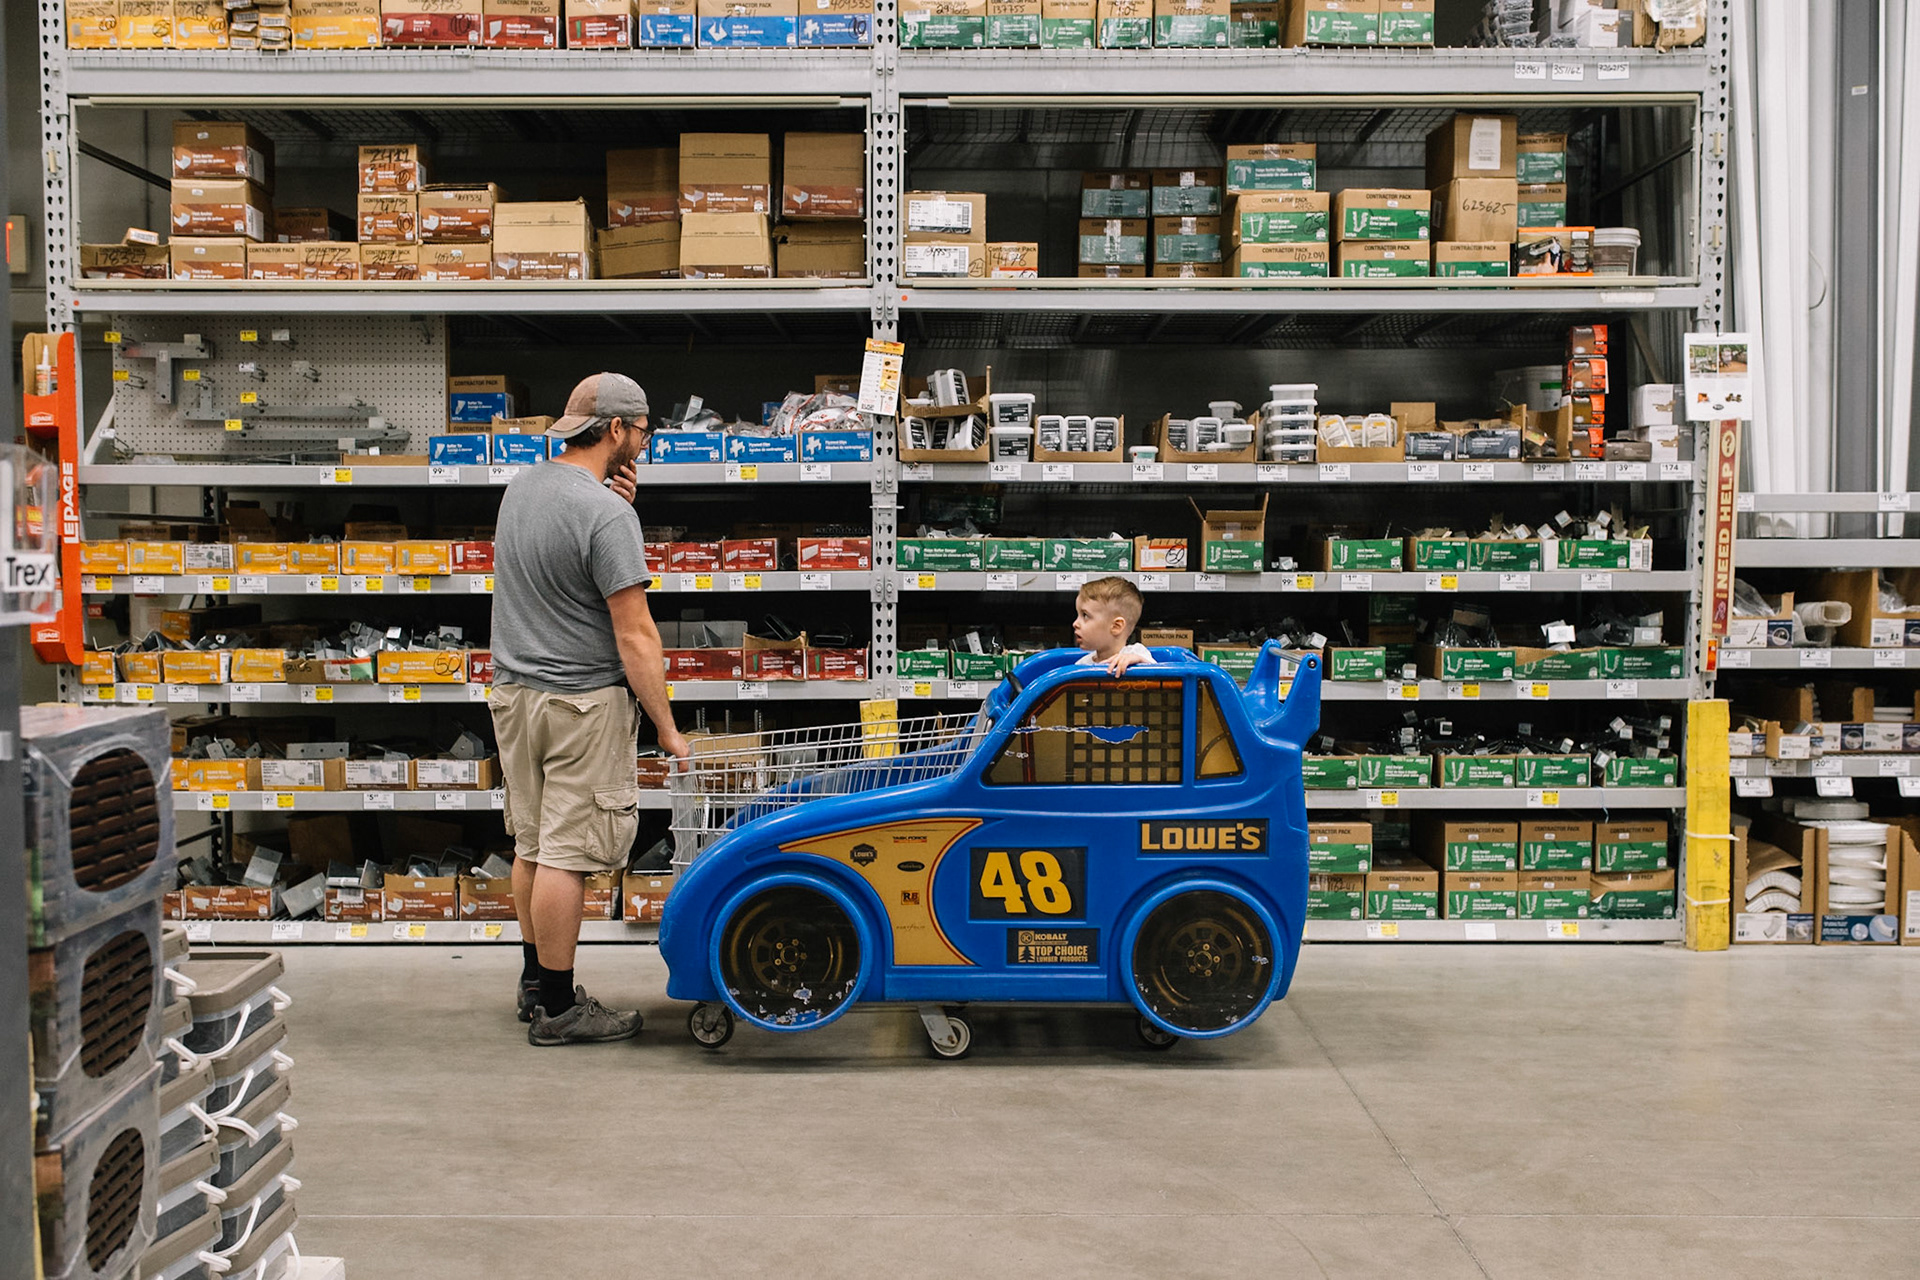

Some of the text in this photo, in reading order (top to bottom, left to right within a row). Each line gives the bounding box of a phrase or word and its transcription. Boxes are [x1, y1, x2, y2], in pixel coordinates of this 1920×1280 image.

[63, 461, 80, 544] LEPAGE
[1717, 462, 1734, 590] NEED HELP
[5, 556, 50, 586] Trex
[435, 656, 462, 674] 50
[1140, 822, 1261, 851] LOWE'S
[979, 850, 1073, 916] 48
[1035, 933, 1067, 941] KOBALT
[1036, 945, 1088, 956] TOP CHOICE
